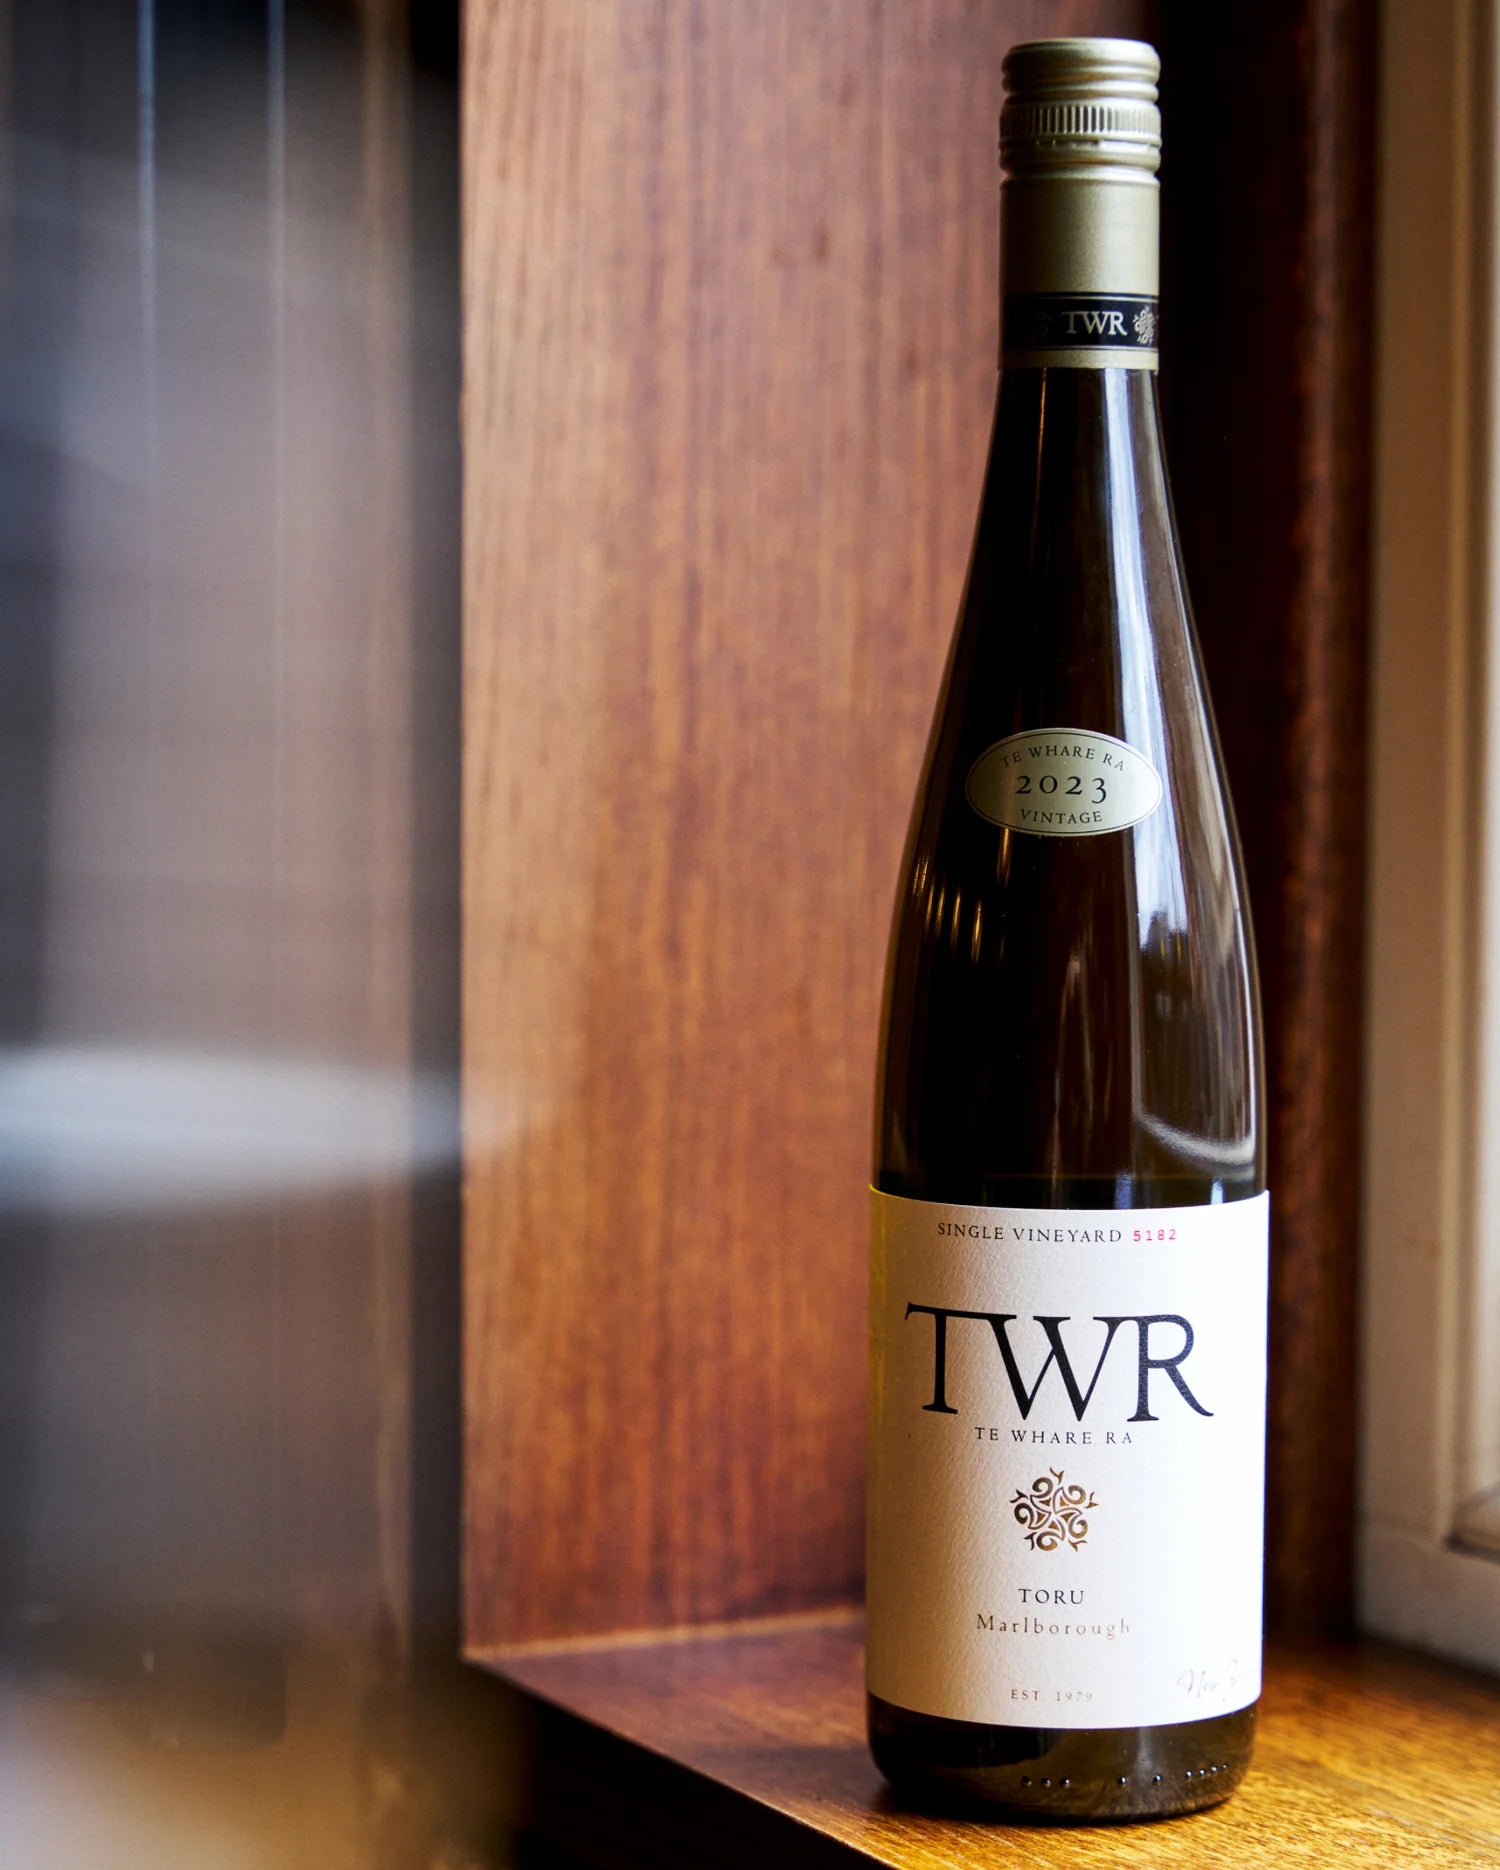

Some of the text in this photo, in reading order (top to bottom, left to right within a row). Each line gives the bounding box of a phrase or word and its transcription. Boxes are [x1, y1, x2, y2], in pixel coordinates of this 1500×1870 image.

[1060, 310, 1128, 336] TWR
[1000, 745, 1125, 772] TE WHARE RA
[1015, 775, 1108, 804] 2023
[1020, 808, 1102, 824] VINTAGE
[937, 1222, 1177, 1243] SINGLE VINEYARD 5182
[904, 1302, 1215, 1423] TWR
[974, 1426, 1133, 1445] TE WHARE RA
[1018, 1588, 1085, 1605] TORU
[976, 1614, 1131, 1640] Marlborough
[1010, 1688, 1094, 1702] EST 1979
